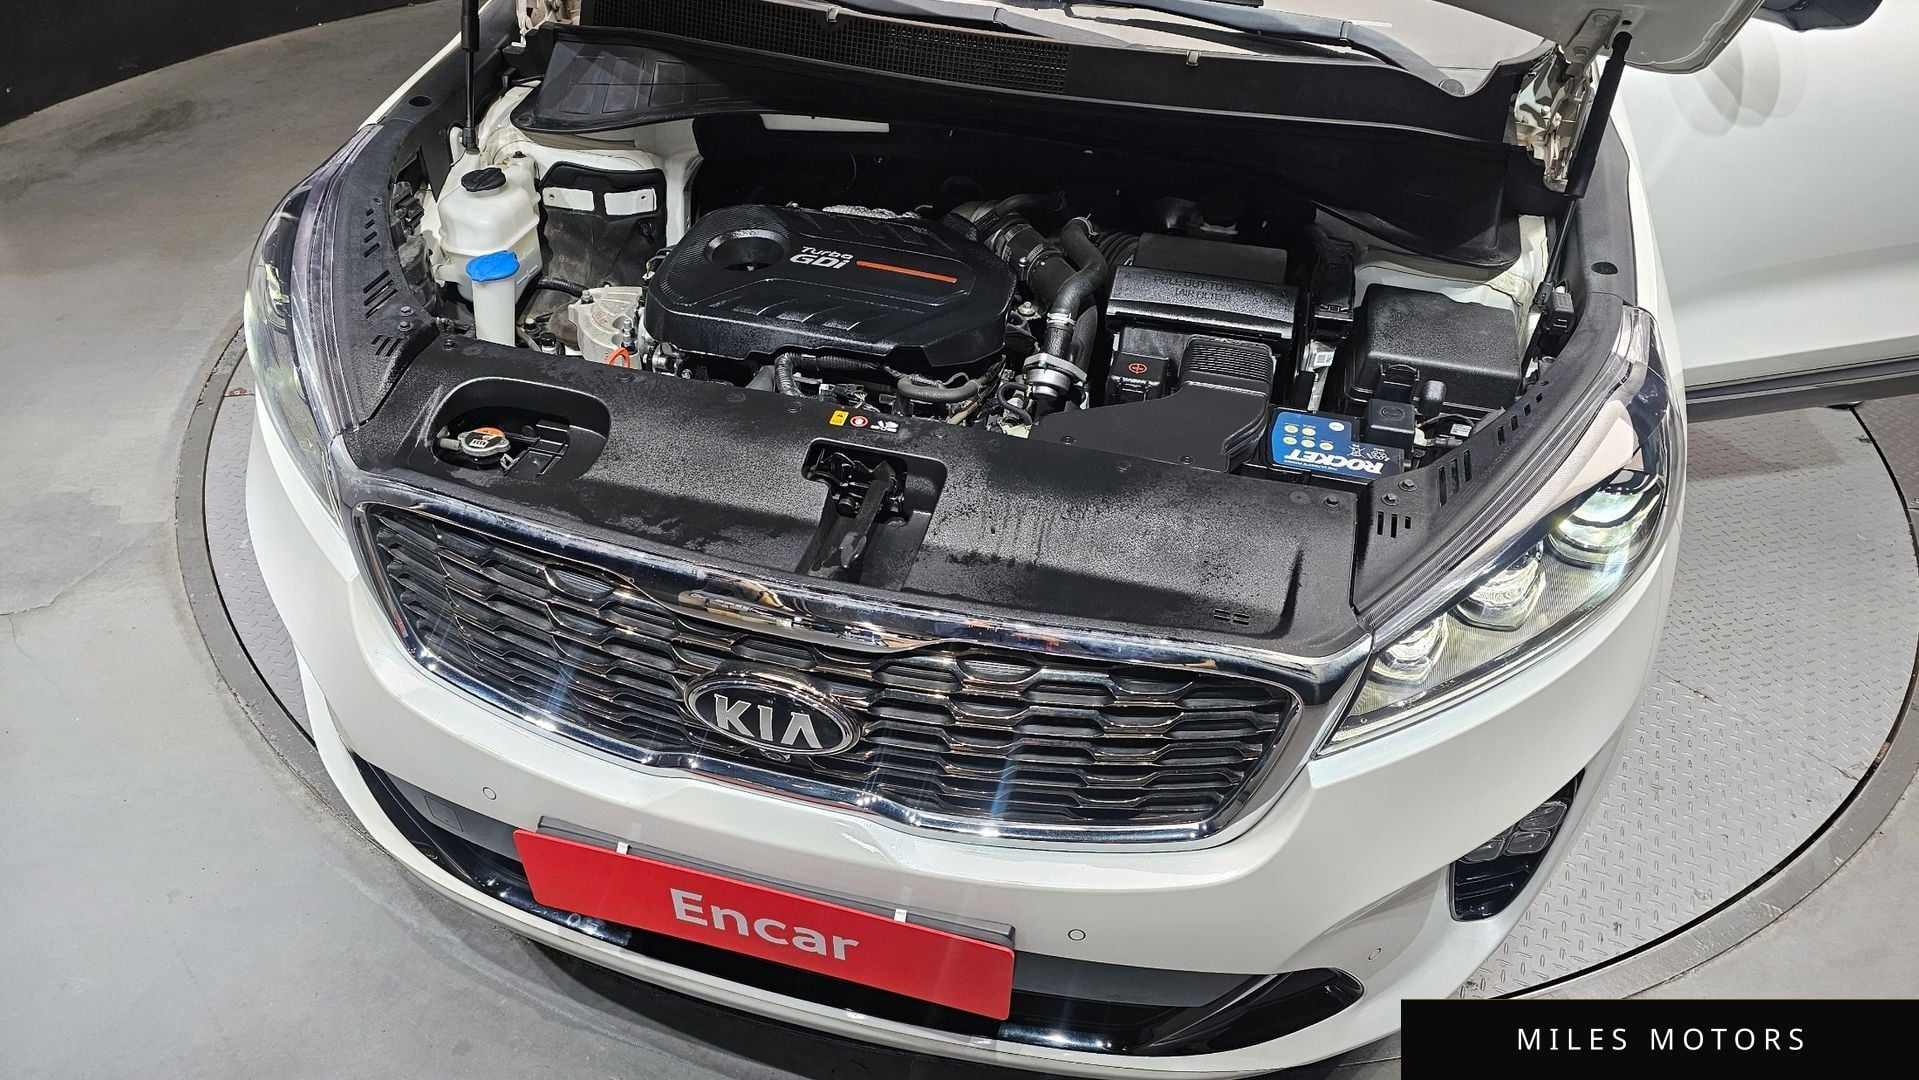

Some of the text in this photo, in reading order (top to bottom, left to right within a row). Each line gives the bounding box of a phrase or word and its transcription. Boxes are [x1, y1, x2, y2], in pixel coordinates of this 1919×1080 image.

[789, 253, 850, 269] GDi
[801, 246, 854, 259] Turbo
[1153, 274, 1181, 286] PULL
[1184, 277, 1206, 289] OUT
[1208, 280, 1225, 291] TO
[1284, 449, 1384, 474] ROCKET
[714, 693, 823, 749] KIA
[670, 887, 860, 961] Encar
